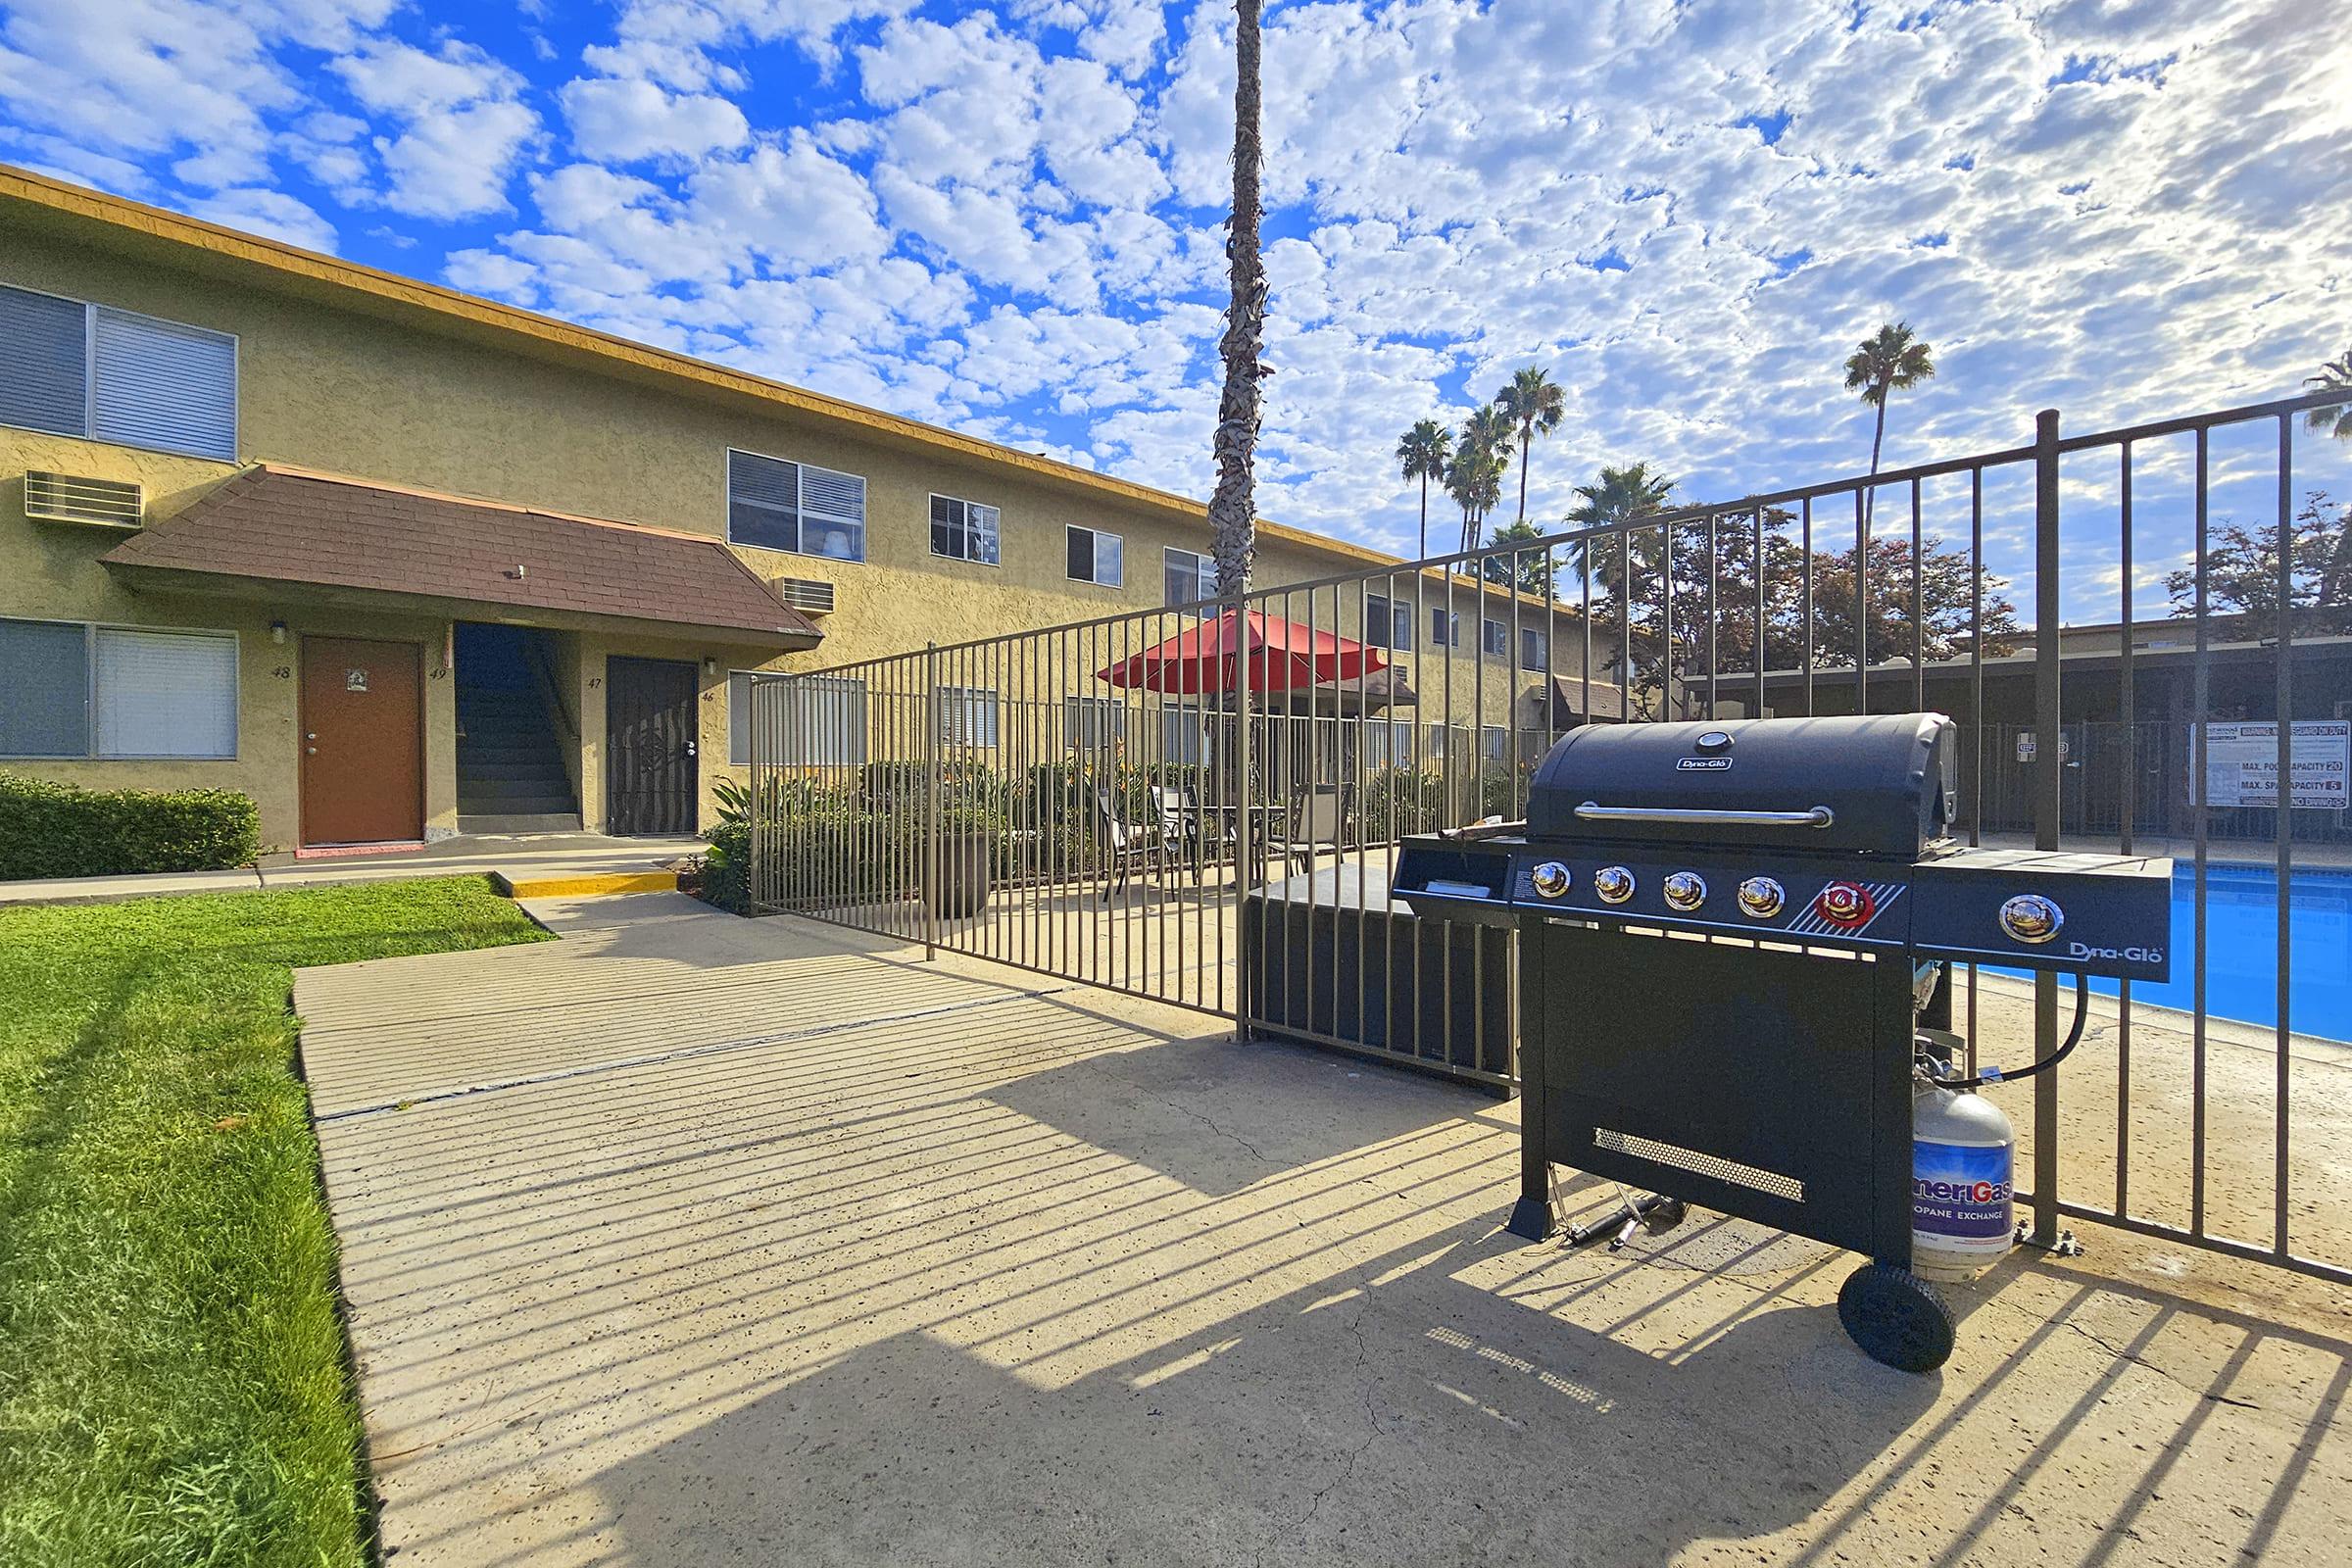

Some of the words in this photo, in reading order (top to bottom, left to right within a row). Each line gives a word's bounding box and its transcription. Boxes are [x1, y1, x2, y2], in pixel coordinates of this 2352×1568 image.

[270, 665, 291, 680] 48
[429, 667, 447, 681] 49
[588, 677, 602, 690] 47
[701, 692, 714, 703] 46
[2241, 762, 2263, 771] MAX.
[2290, 762, 2326, 771] APACITY
[2328, 762, 2342, 771] 20
[2240, 781, 2263, 790] MAX.
[2290, 781, 2326, 790] APACITY
[2070, 942, 2163, 963] Dyna-Glo
[1913, 1176, 2014, 1203] meriGas
[1913, 1205, 1953, 1219] OPANE
[1957, 1209, 2003, 1221] EXCHANGE
